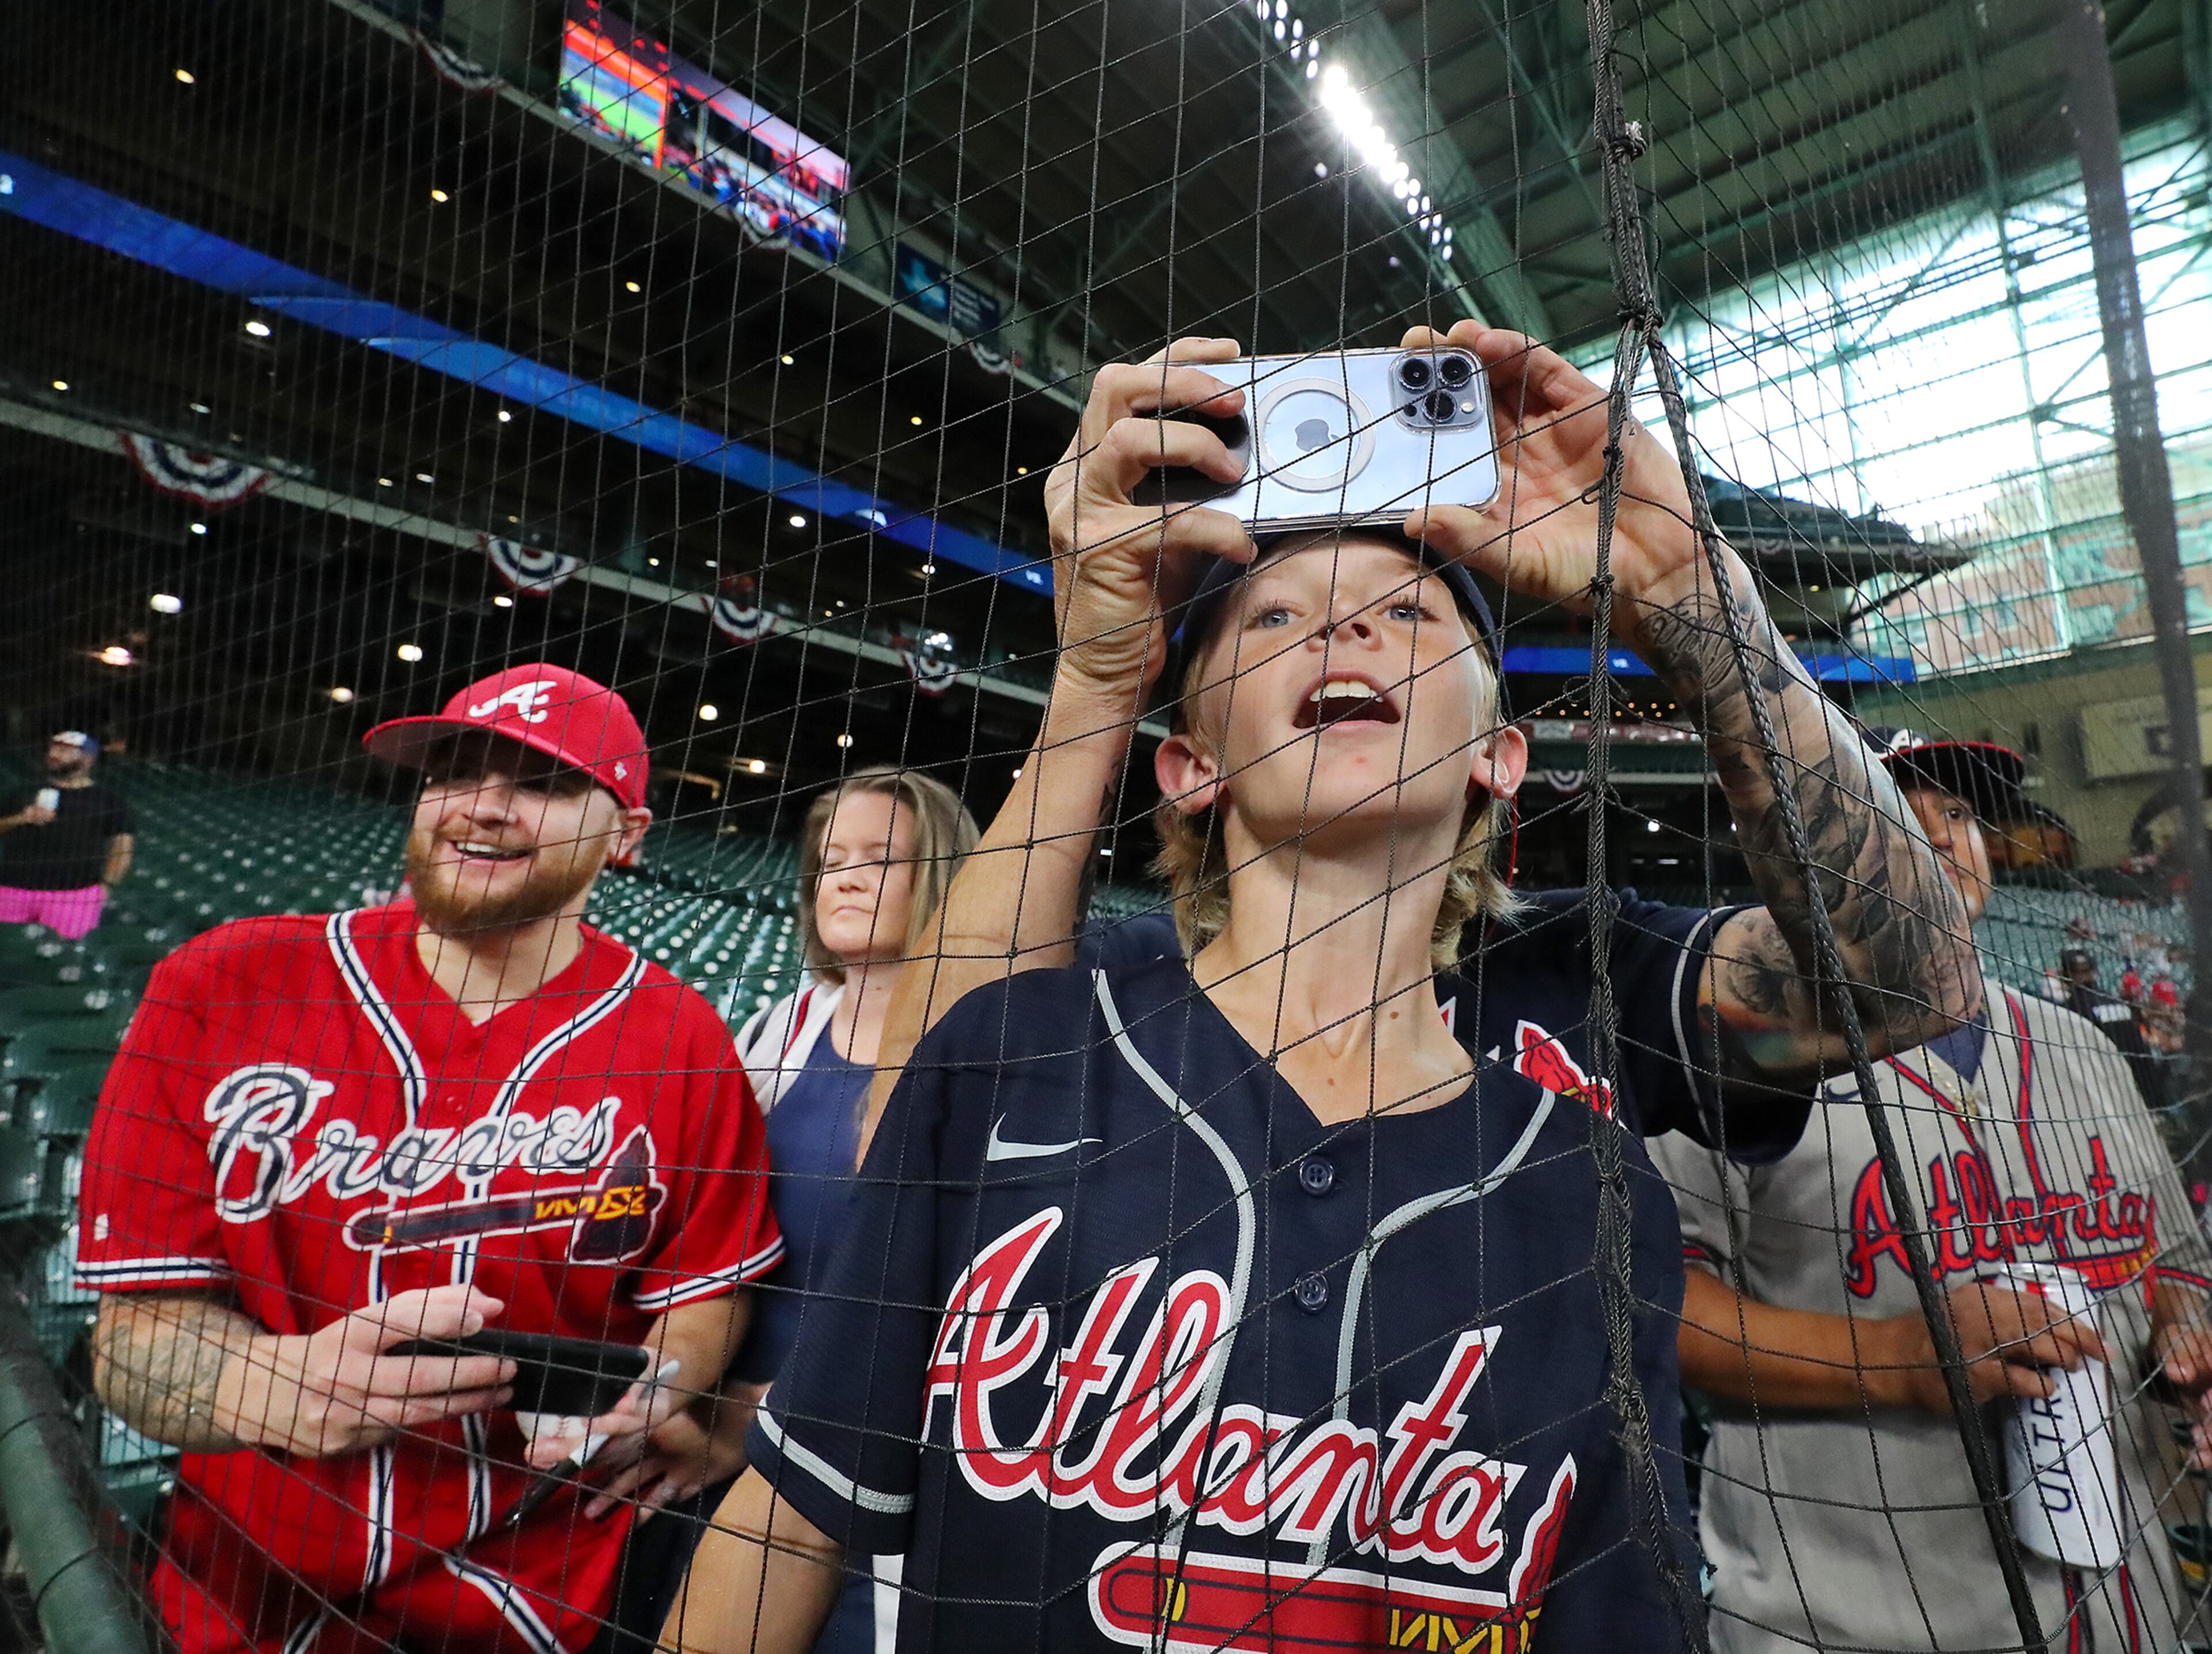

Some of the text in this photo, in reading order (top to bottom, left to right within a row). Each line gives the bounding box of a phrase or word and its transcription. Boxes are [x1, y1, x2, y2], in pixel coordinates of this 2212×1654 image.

[468, 680, 557, 723] A
[204, 1062, 622, 1223] Braves
[1845, 1135, 2145, 1299] Atlanta
[920, 1205, 1528, 1574] Atlanta
[2029, 1383, 2074, 1513] ULTR
